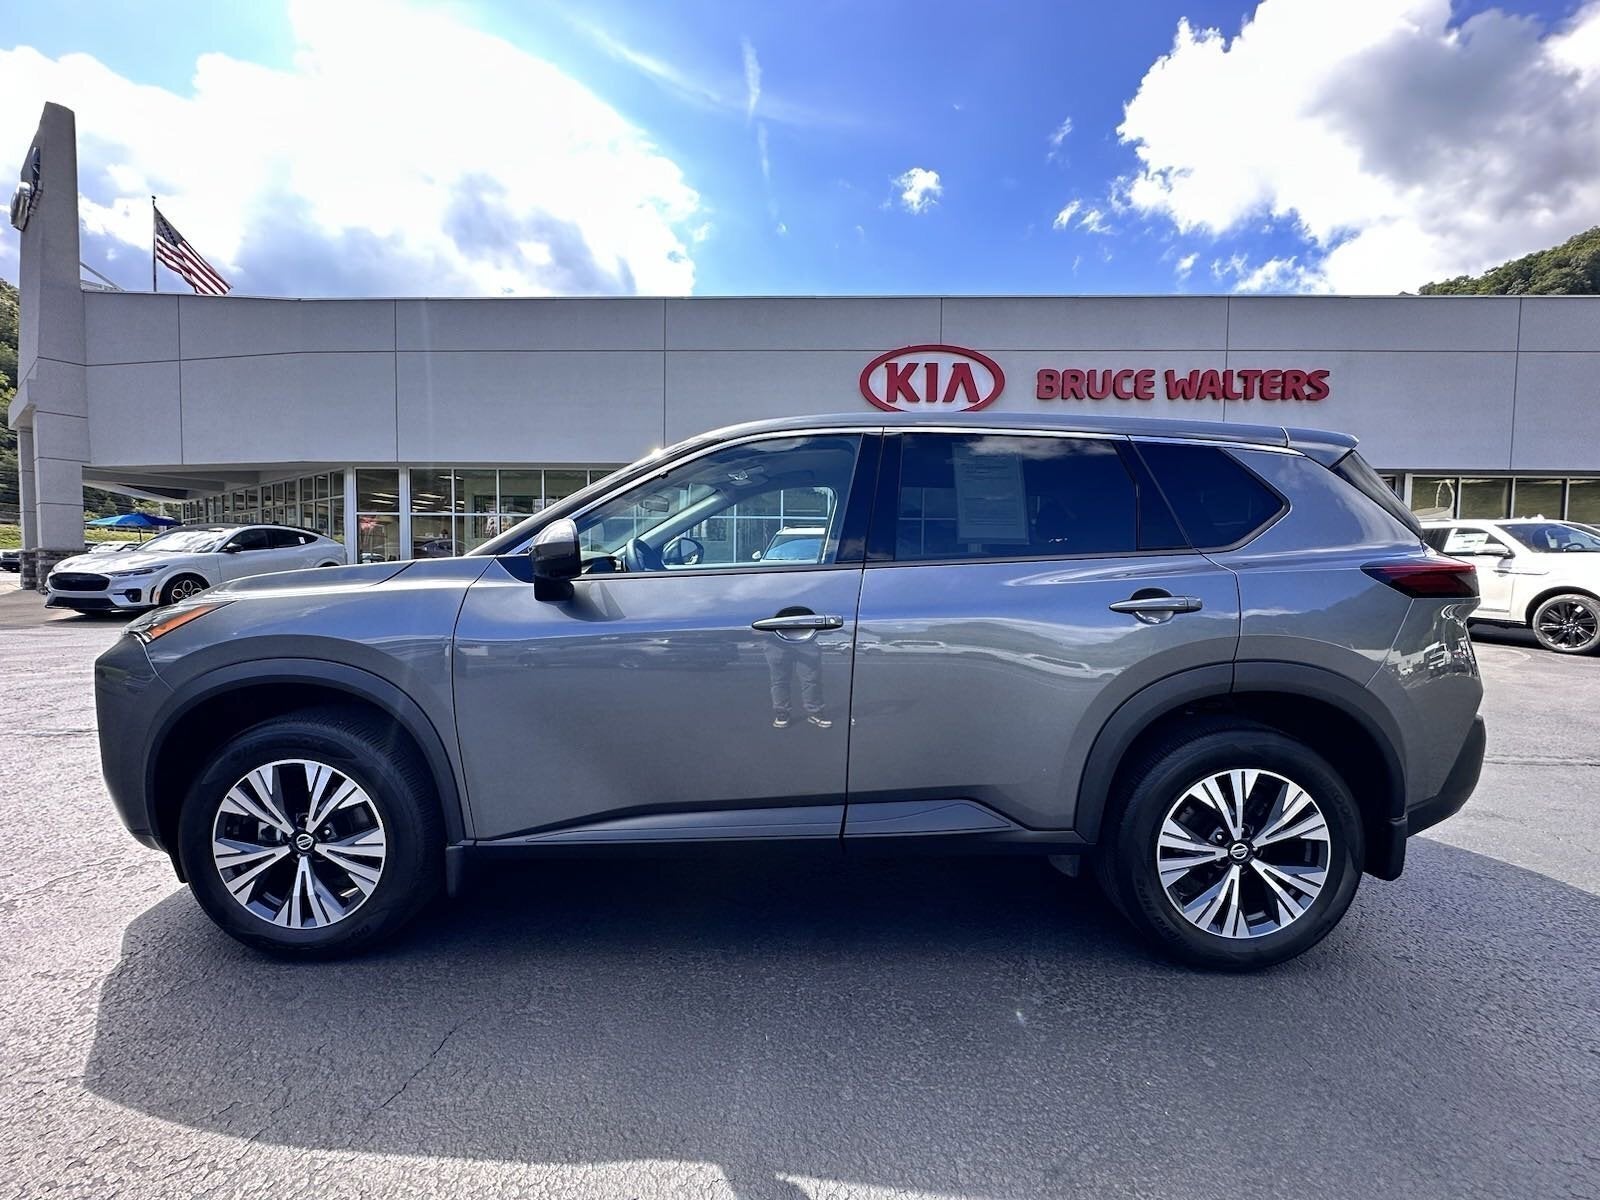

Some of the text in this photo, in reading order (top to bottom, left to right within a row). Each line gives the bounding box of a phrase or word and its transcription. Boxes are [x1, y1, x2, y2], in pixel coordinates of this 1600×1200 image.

[885, 363, 980, 403] KIA
[1036, 369, 1330, 402] BRUCE WALTERS
